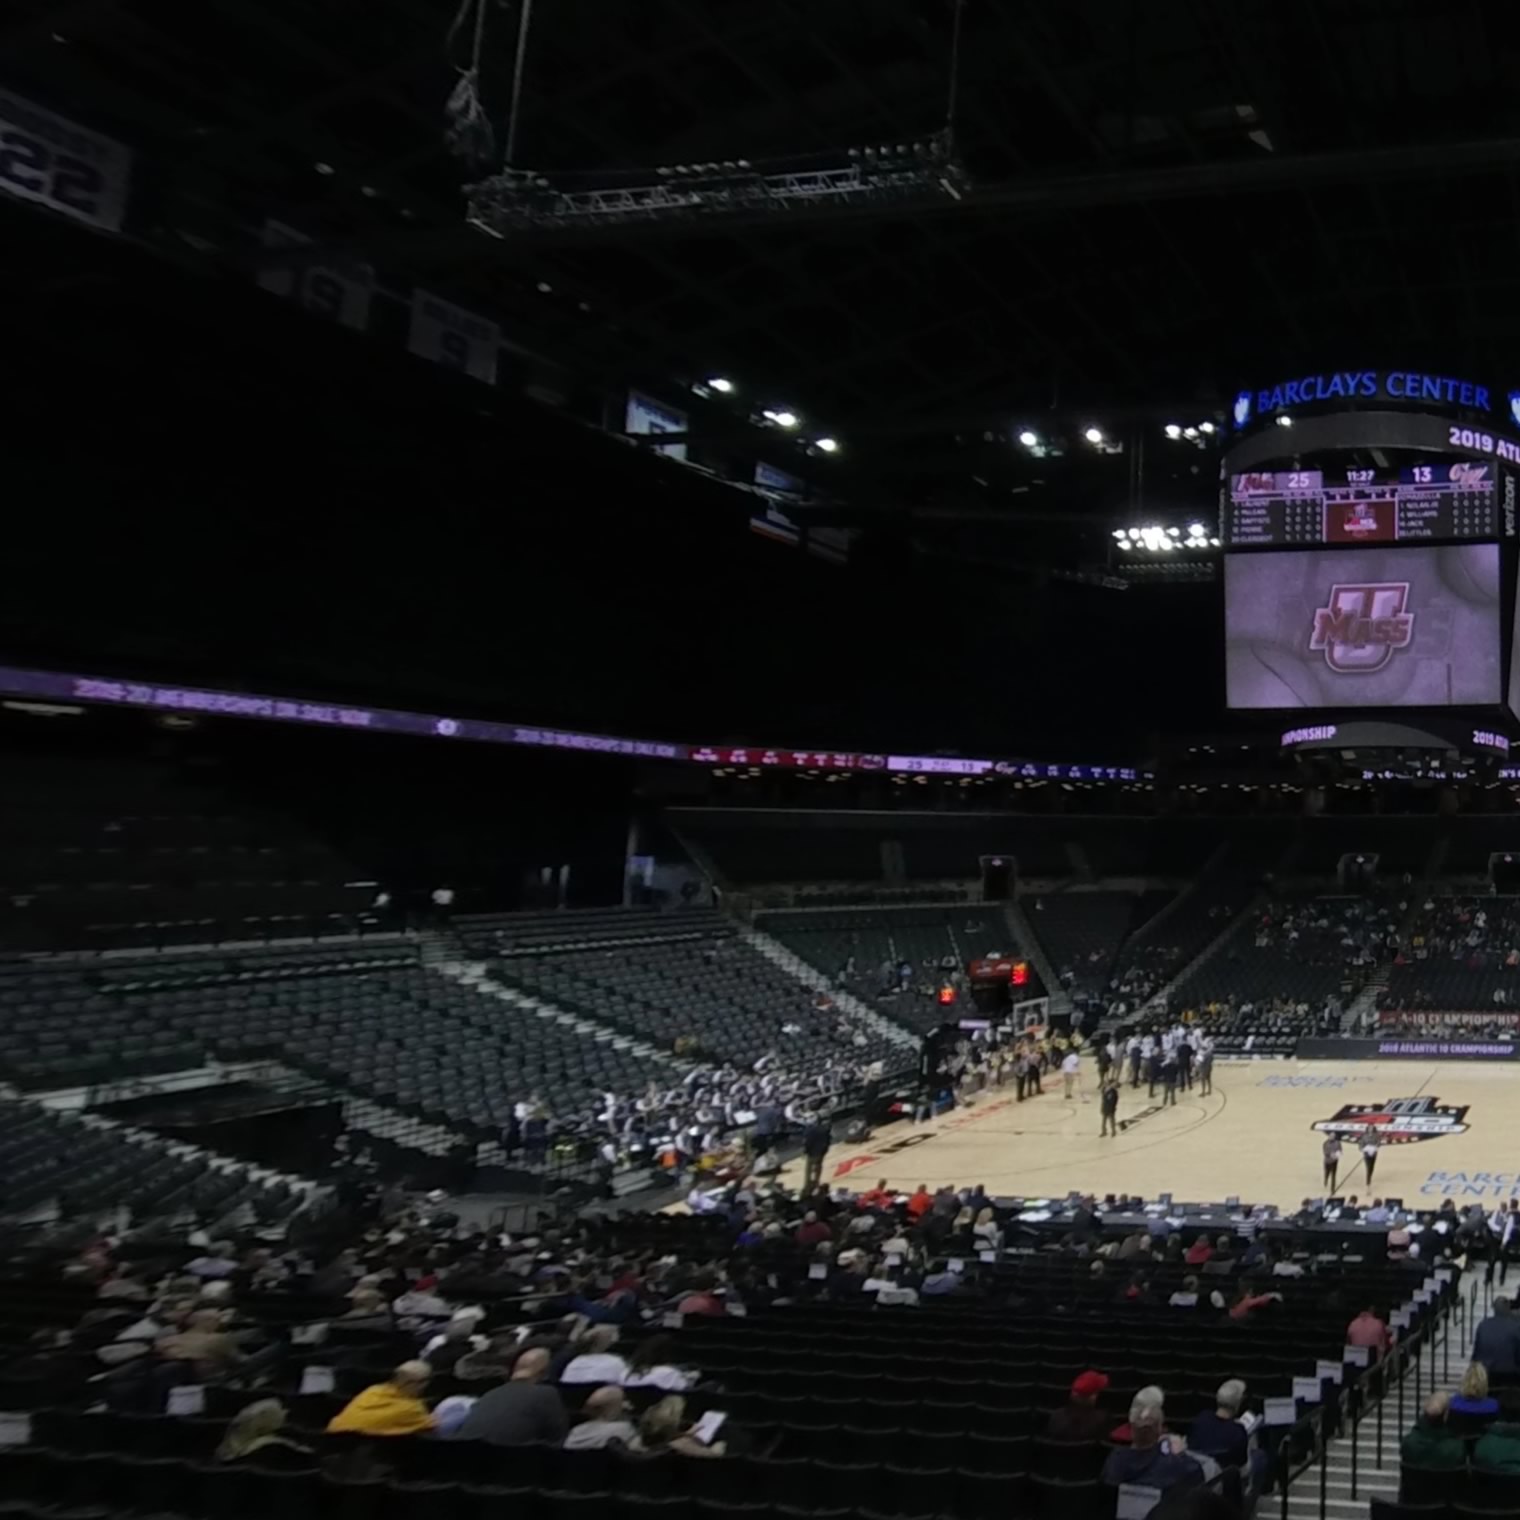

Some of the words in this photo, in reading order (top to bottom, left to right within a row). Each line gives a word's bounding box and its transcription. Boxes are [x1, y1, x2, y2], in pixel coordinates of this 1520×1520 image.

[1257, 372, 1376, 413] BARCLAYS
[1386, 372, 1490, 411] CENTER
[1449, 427, 1493, 452] 2019
[1288, 472, 1310, 488] 25
[1347, 469, 1375, 481] 11:27
[1412, 467, 1432, 482] 13
[1503, 476, 1516, 536] verizon
[1472, 730, 1494, 746] 2019
[1400, 1043, 1438, 1053] ATLANTIC
[1450, 1044, 1514, 1055] CHAMPIONSHIP
